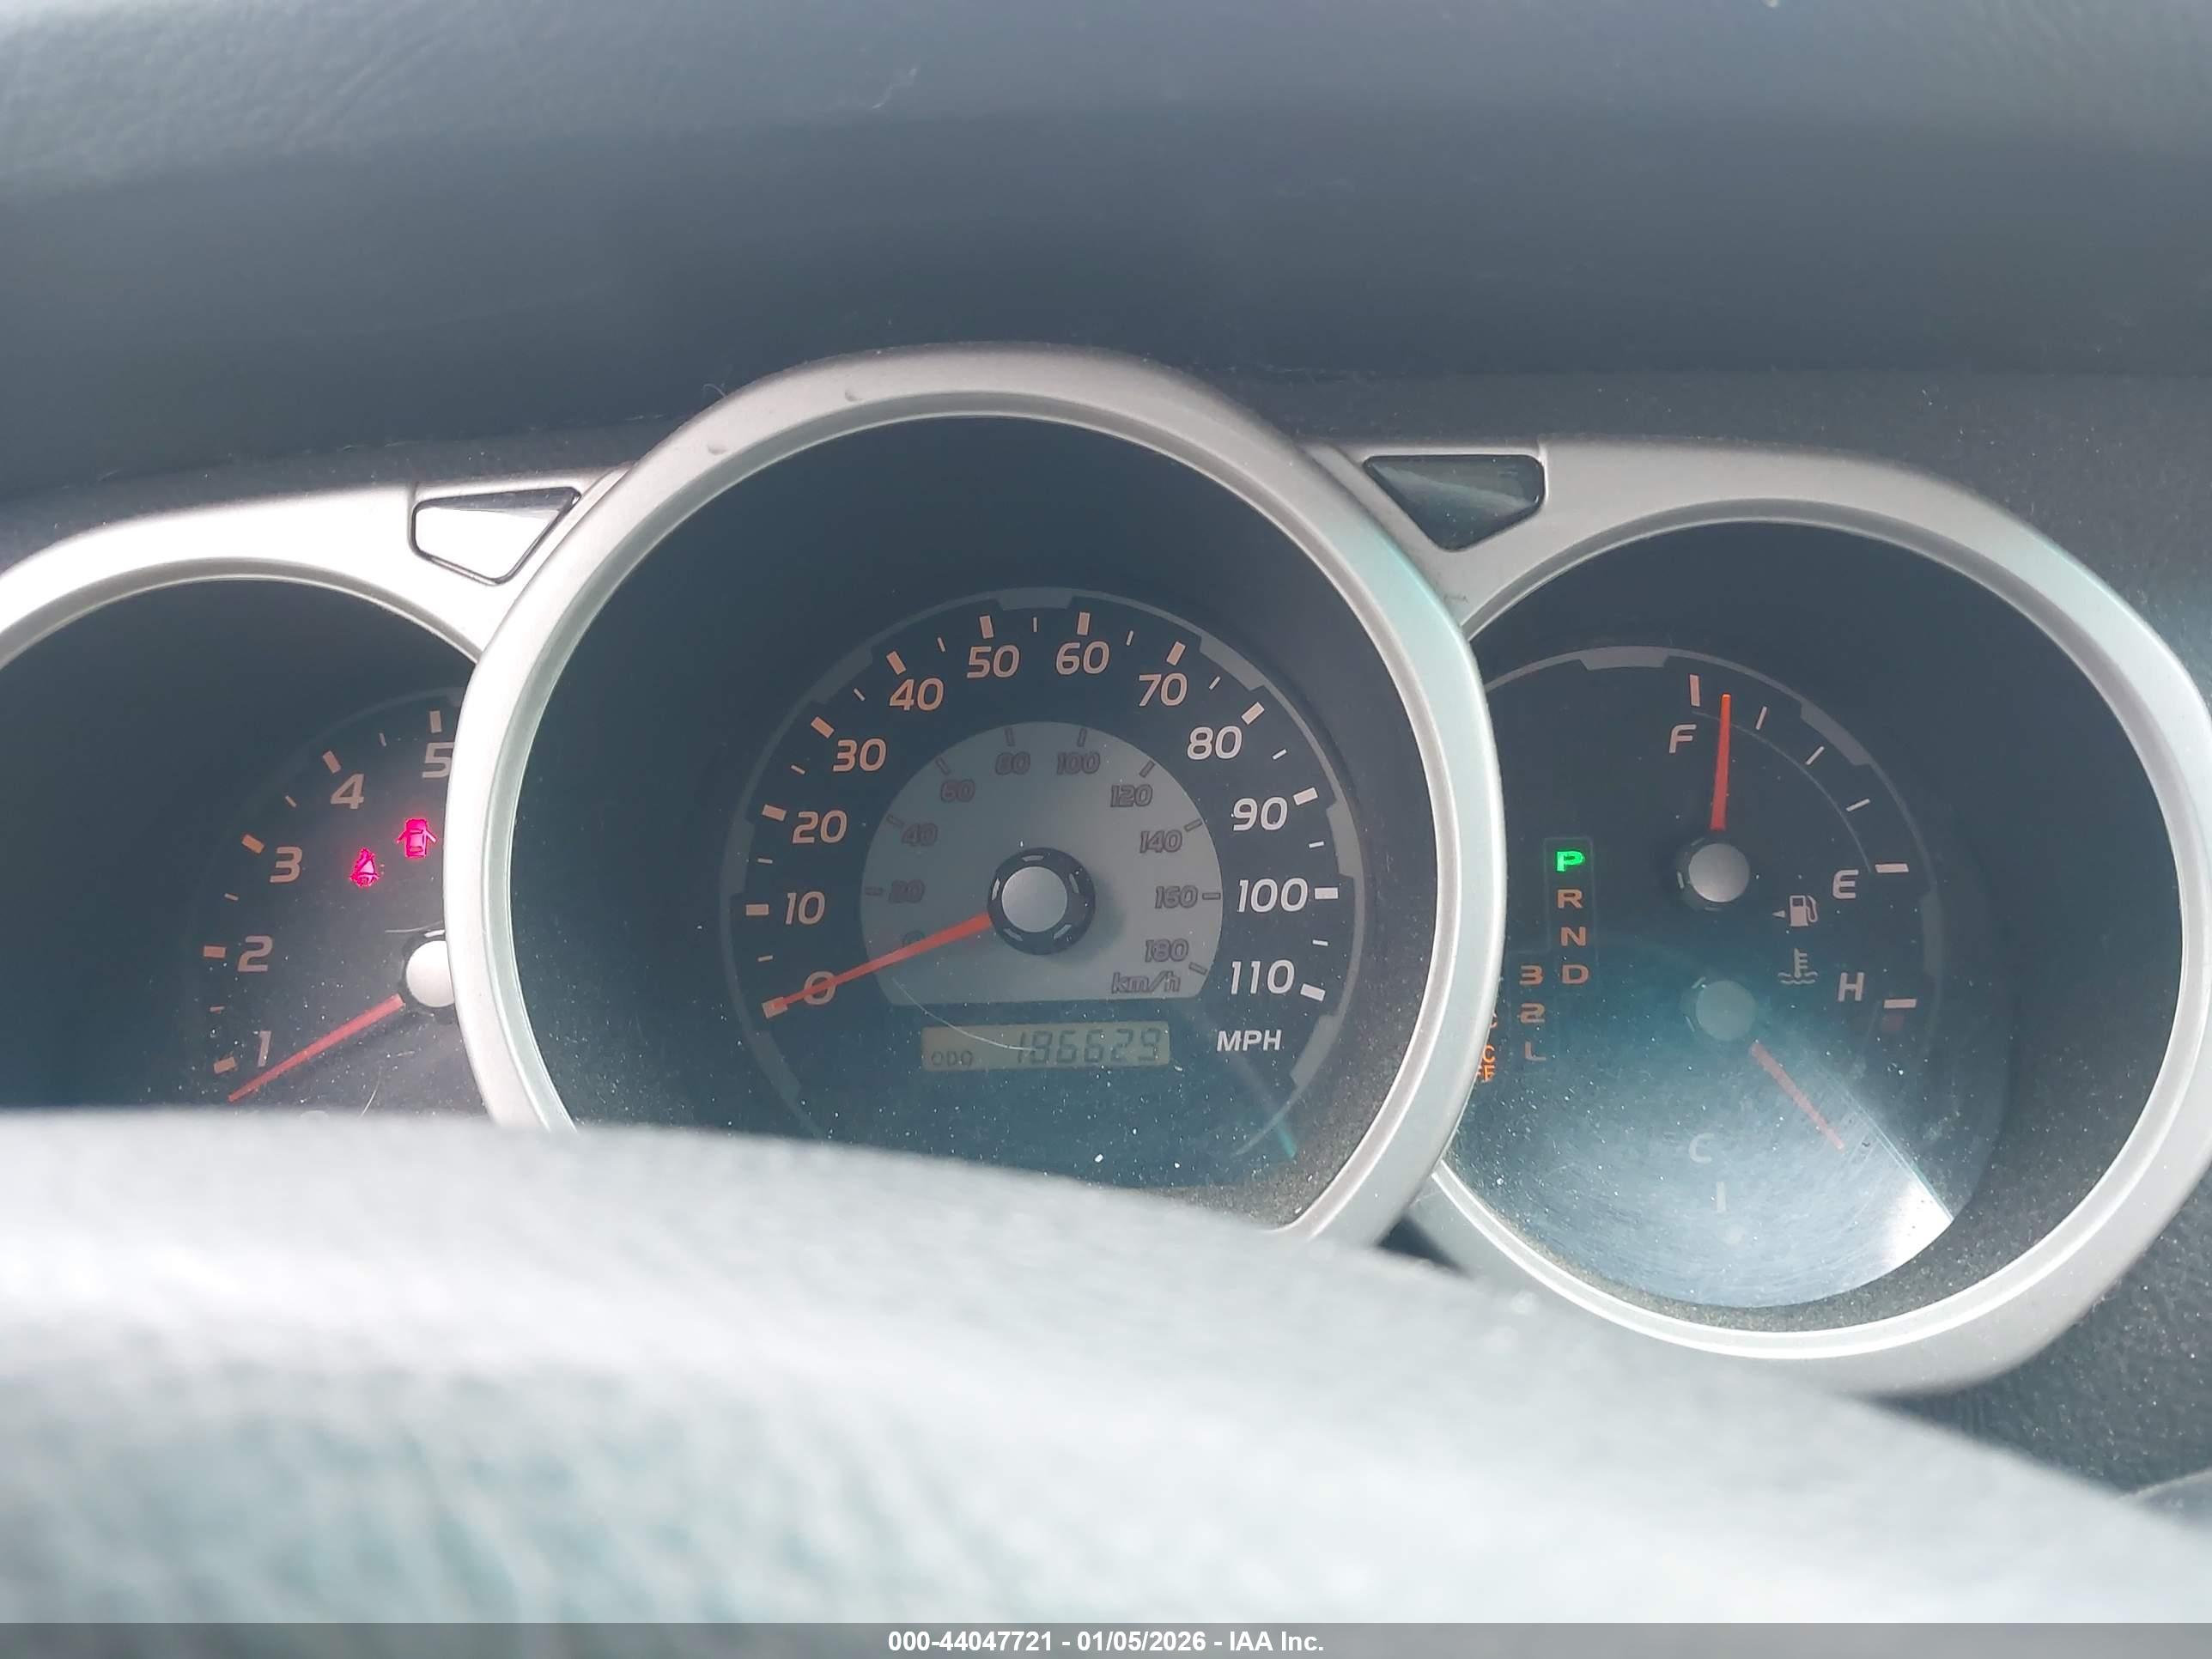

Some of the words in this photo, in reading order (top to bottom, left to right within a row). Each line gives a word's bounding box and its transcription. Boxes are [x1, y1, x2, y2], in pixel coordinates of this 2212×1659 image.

[966, 644, 1020, 679] 50
[1054, 640, 1110, 677] 60
[889, 677, 944, 711] 40
[1139, 672, 1188, 708] 70
[1186, 725, 1243, 761] 80
[1668, 723, 1697, 753] F
[422, 742, 454, 778] 5
[833, 738, 887, 773] 30
[995, 752, 1030, 775] 80
[1057, 751, 1100, 775] 100
[331, 774, 365, 809] 4
[940, 779, 975, 802] 60
[1110, 784, 1152, 807] 120
[791, 809, 848, 845] 20
[1232, 796, 1288, 832] 90
[902, 823, 939, 847] 40
[1139, 830, 1182, 853] 140
[270, 847, 302, 883] 3
[1556, 850, 1585, 872] P
[1155, 885, 1198, 908] 160
[1237, 878, 1310, 913] 100
[1832, 869, 1858, 898] E
[784, 890, 825, 926] 10
[1558, 889, 1583, 908] R
[1145, 939, 1188, 963] 180
[1560, 927, 1587, 946] N
[237, 935, 272, 972] 2
[802, 970, 837, 1006] 0
[1111, 971, 1181, 994] km/h
[1230, 959, 1295, 995] 110
[1520, 965, 1543, 985] 3
[1561, 965, 1589, 984] D
[1838, 971, 1865, 1001] H
[1520, 1002, 1545, 1024] 2
[254, 1030, 271, 1066] 1
[1017, 1027, 1162, 1065] 186629
[1217, 1030, 1282, 1053] MPH
[1524, 1040, 1547, 1061] L
[931, 1050, 974, 1067] ODO
[1689, 1134, 1712, 1163] C
